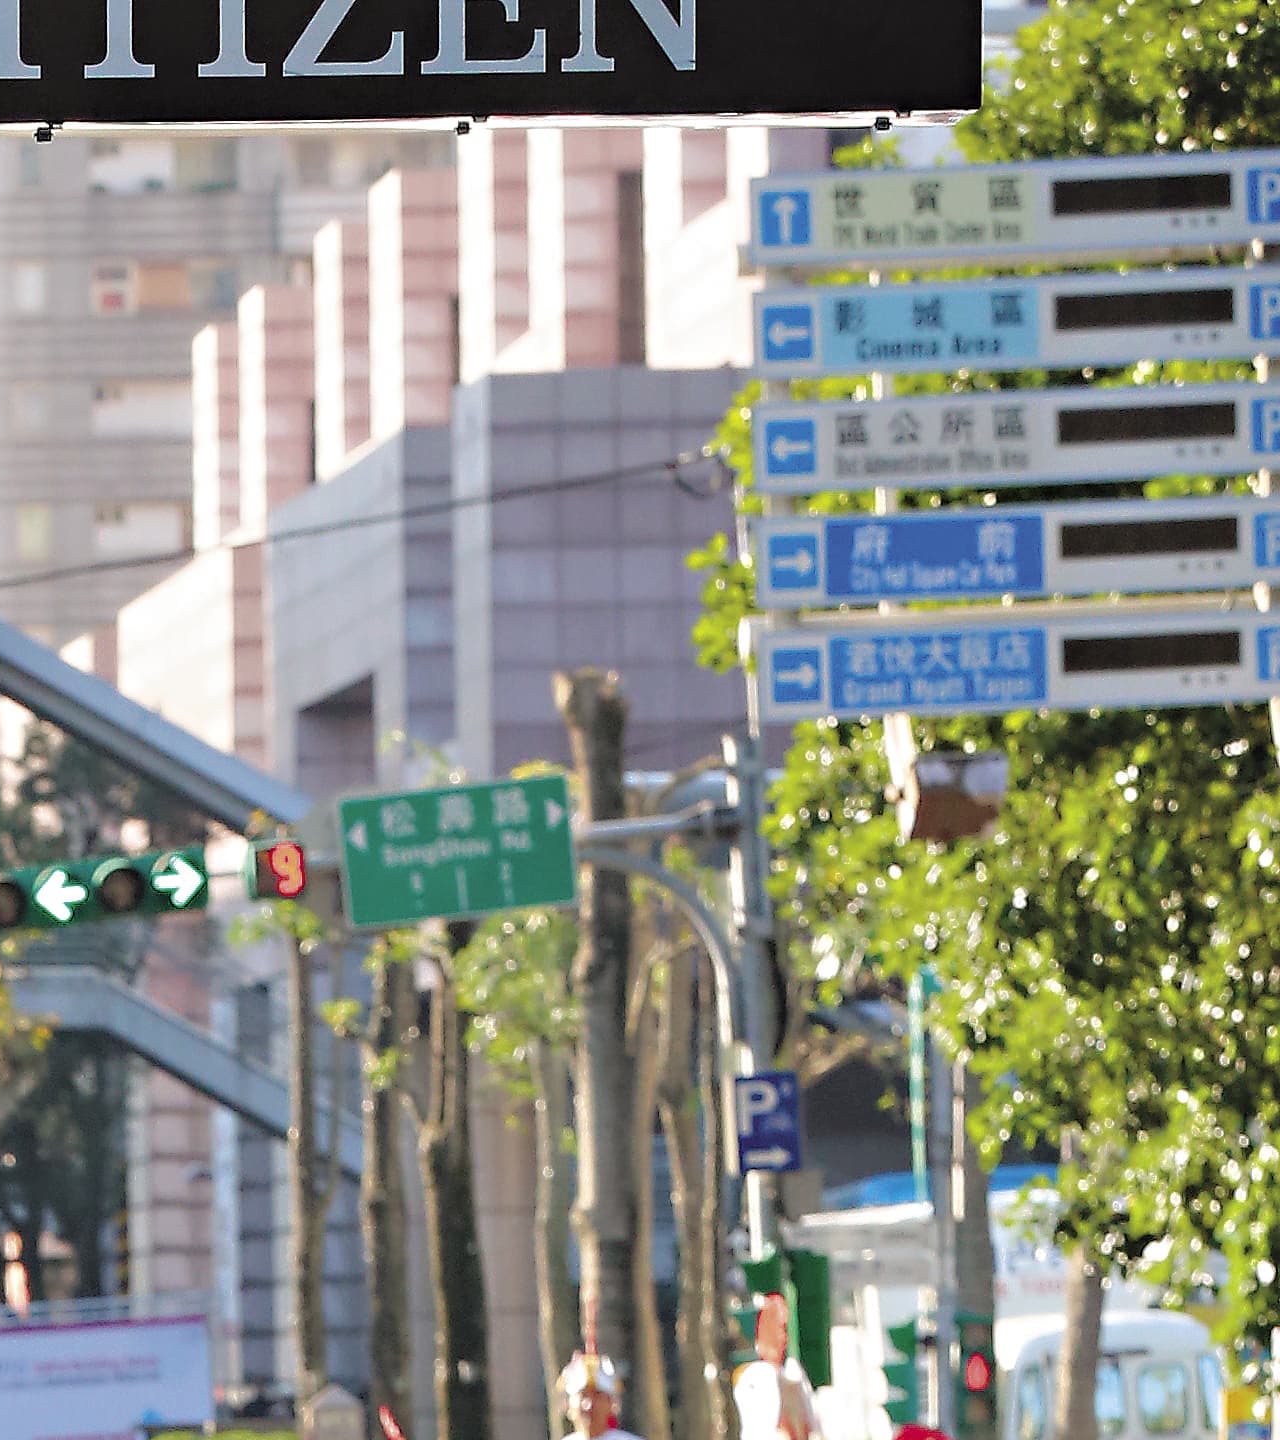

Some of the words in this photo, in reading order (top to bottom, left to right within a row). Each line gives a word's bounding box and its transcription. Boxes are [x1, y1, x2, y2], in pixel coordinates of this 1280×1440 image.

[858, 339, 940, 361] Cinema
[953, 333, 1001, 353] Area
[736, 1080, 778, 1136] P
